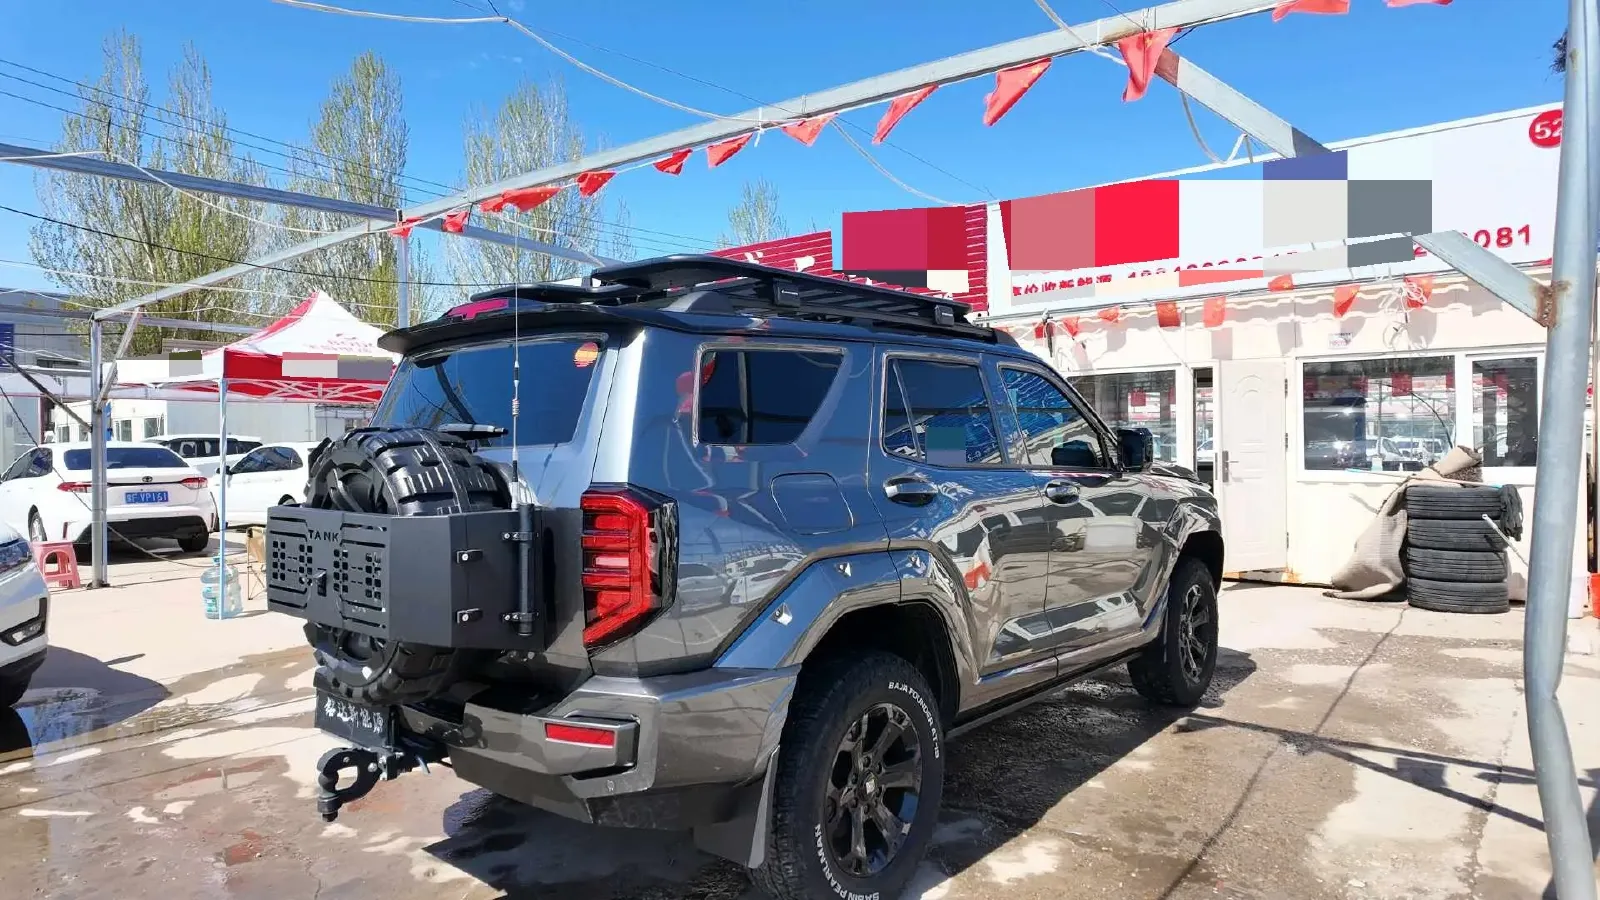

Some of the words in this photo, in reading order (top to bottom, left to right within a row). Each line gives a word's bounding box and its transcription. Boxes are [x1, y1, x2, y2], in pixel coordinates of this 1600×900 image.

[308, 529, 339, 542] TANK
[888, 681, 909, 693] BAJA
[908, 687, 935, 727] FOUNDER
